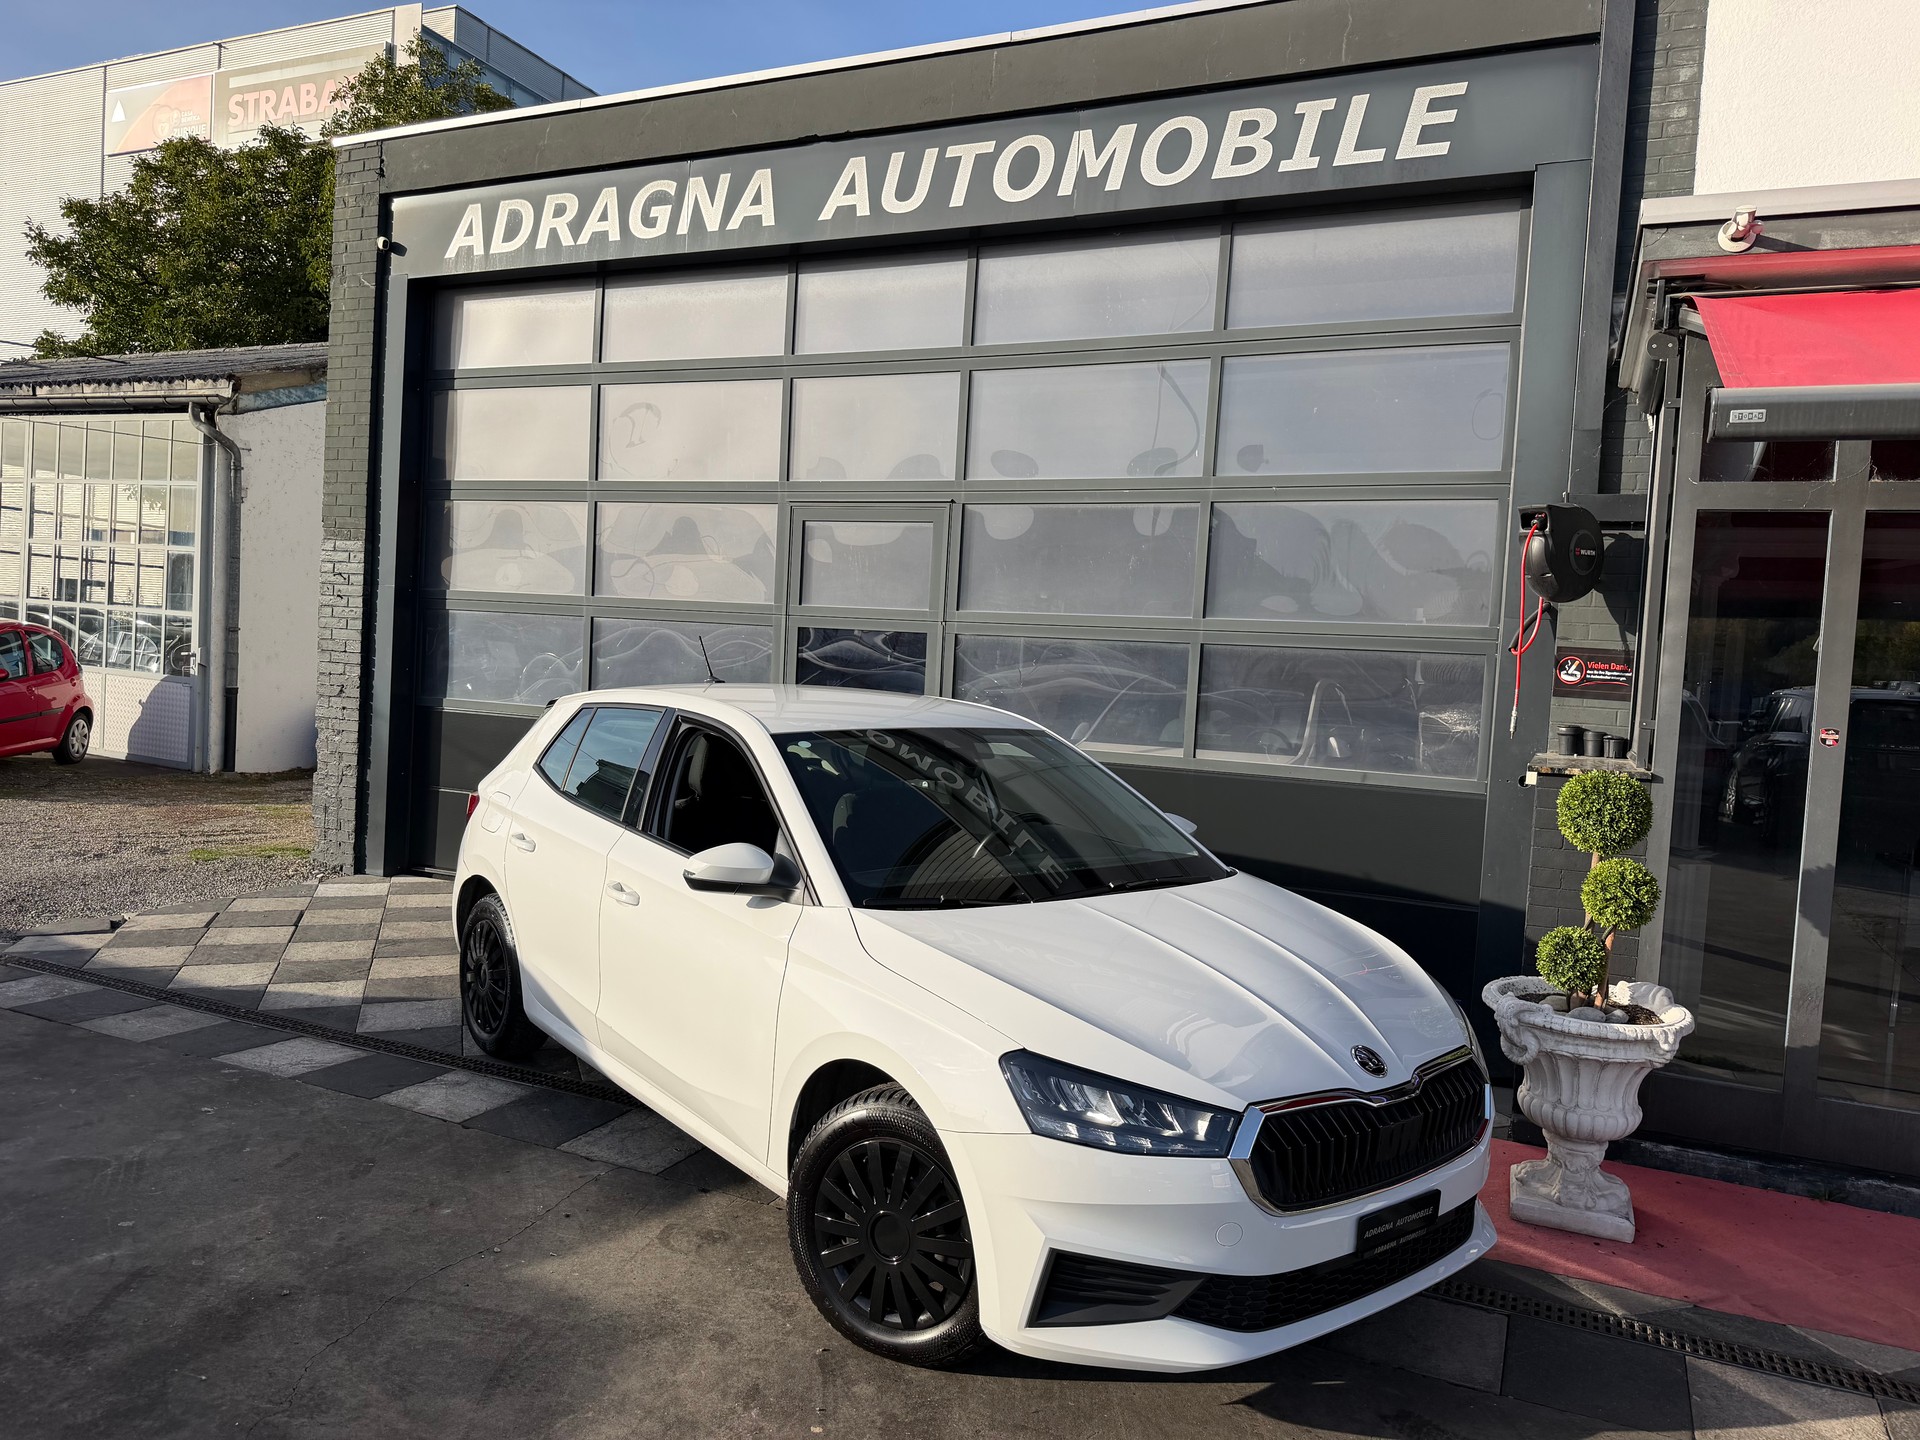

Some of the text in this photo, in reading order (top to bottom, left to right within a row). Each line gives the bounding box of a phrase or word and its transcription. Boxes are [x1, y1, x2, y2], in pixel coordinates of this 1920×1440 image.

[444, 81, 1469, 259] ADRAGNA AUTOMOBILE
[1587, 661, 1610, 670] Vielen
[1610, 662, 1632, 673] Dank,
[1364, 1206, 1434, 1239] ADRAGNA AUTOMOBILE
